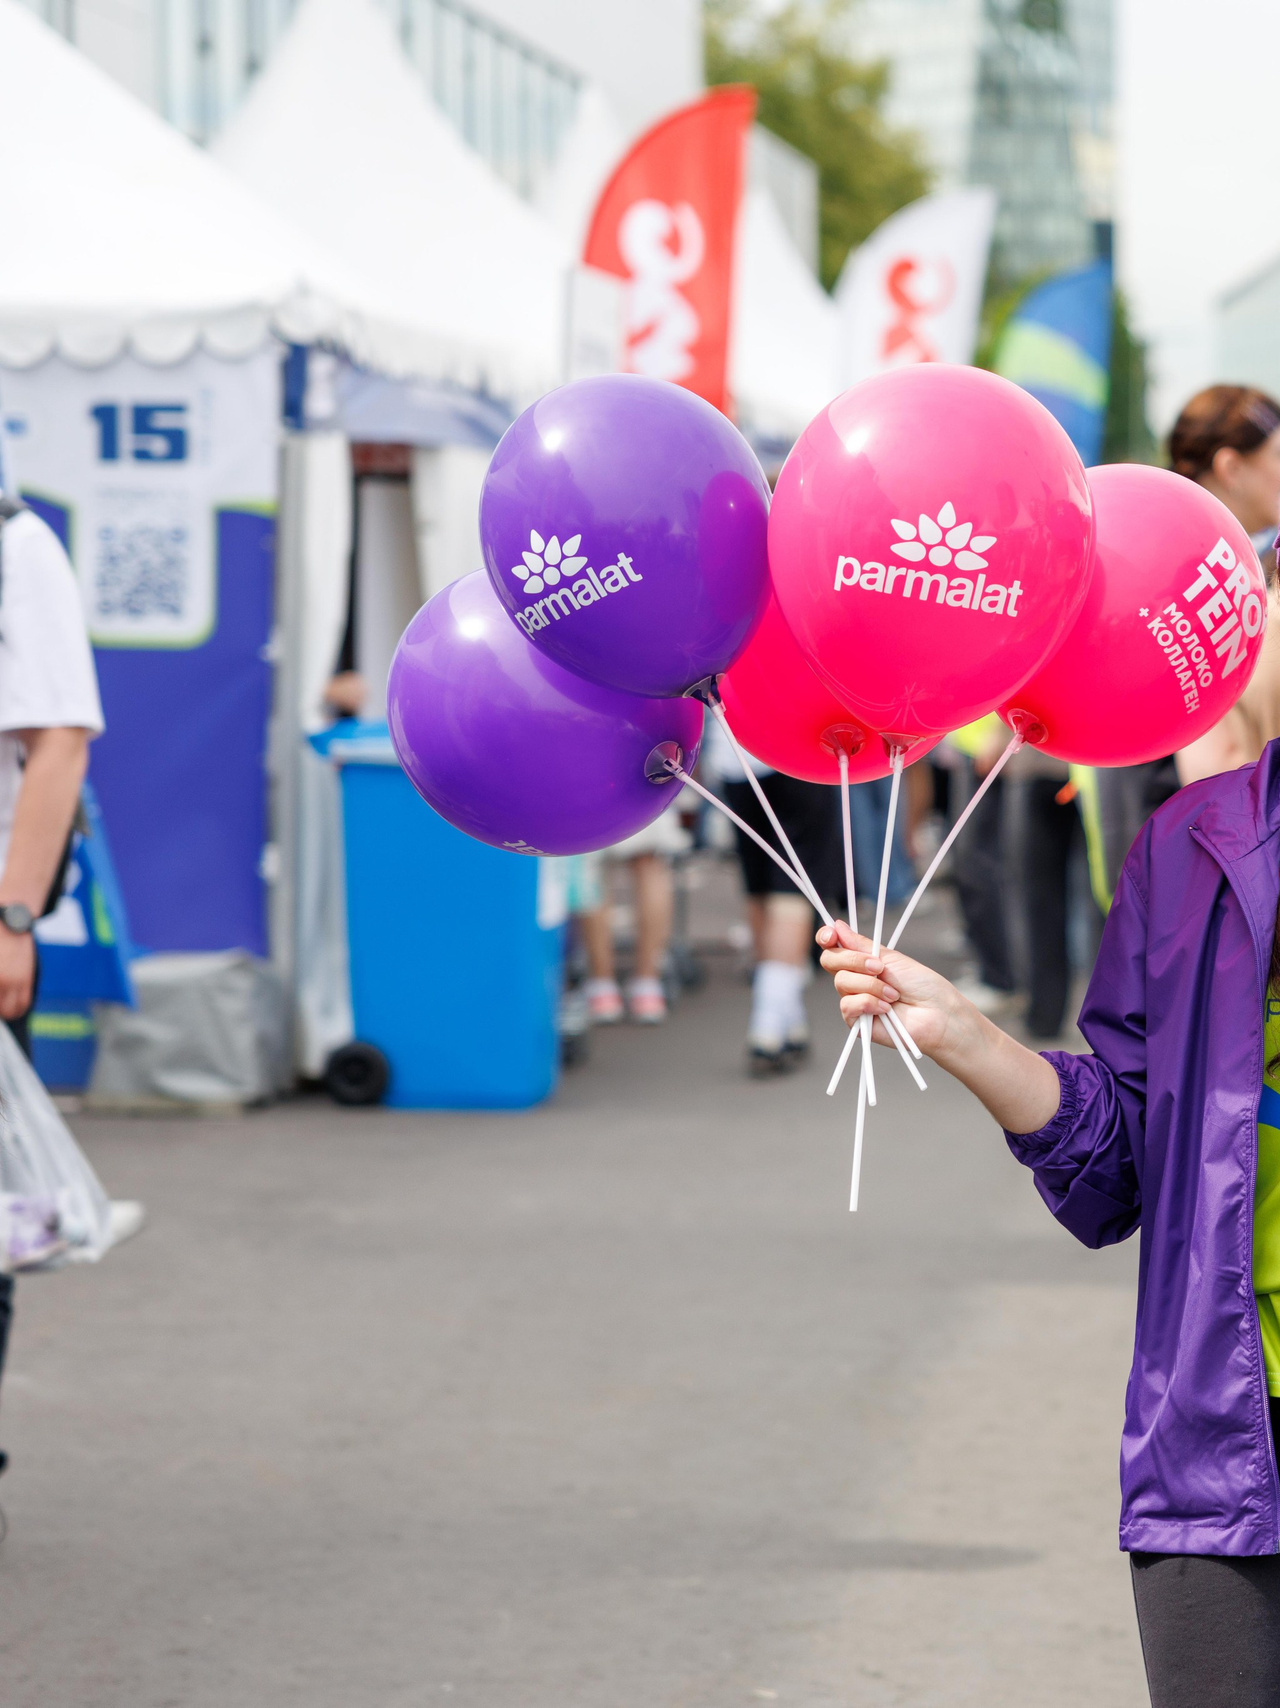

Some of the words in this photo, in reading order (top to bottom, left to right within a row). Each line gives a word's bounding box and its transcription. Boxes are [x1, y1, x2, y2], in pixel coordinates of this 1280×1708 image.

[92, 404, 187, 461] 15
[514, 552, 644, 641] parmalat
[833, 555, 1024, 618] parmalat
[1182, 562, 1248, 680] TEIN
[1205, 536, 1262, 638] PRO
[1146, 616, 1201, 714] КОЛЛАГЕН
[1162, 602, 1214, 688] МОЛОКО
